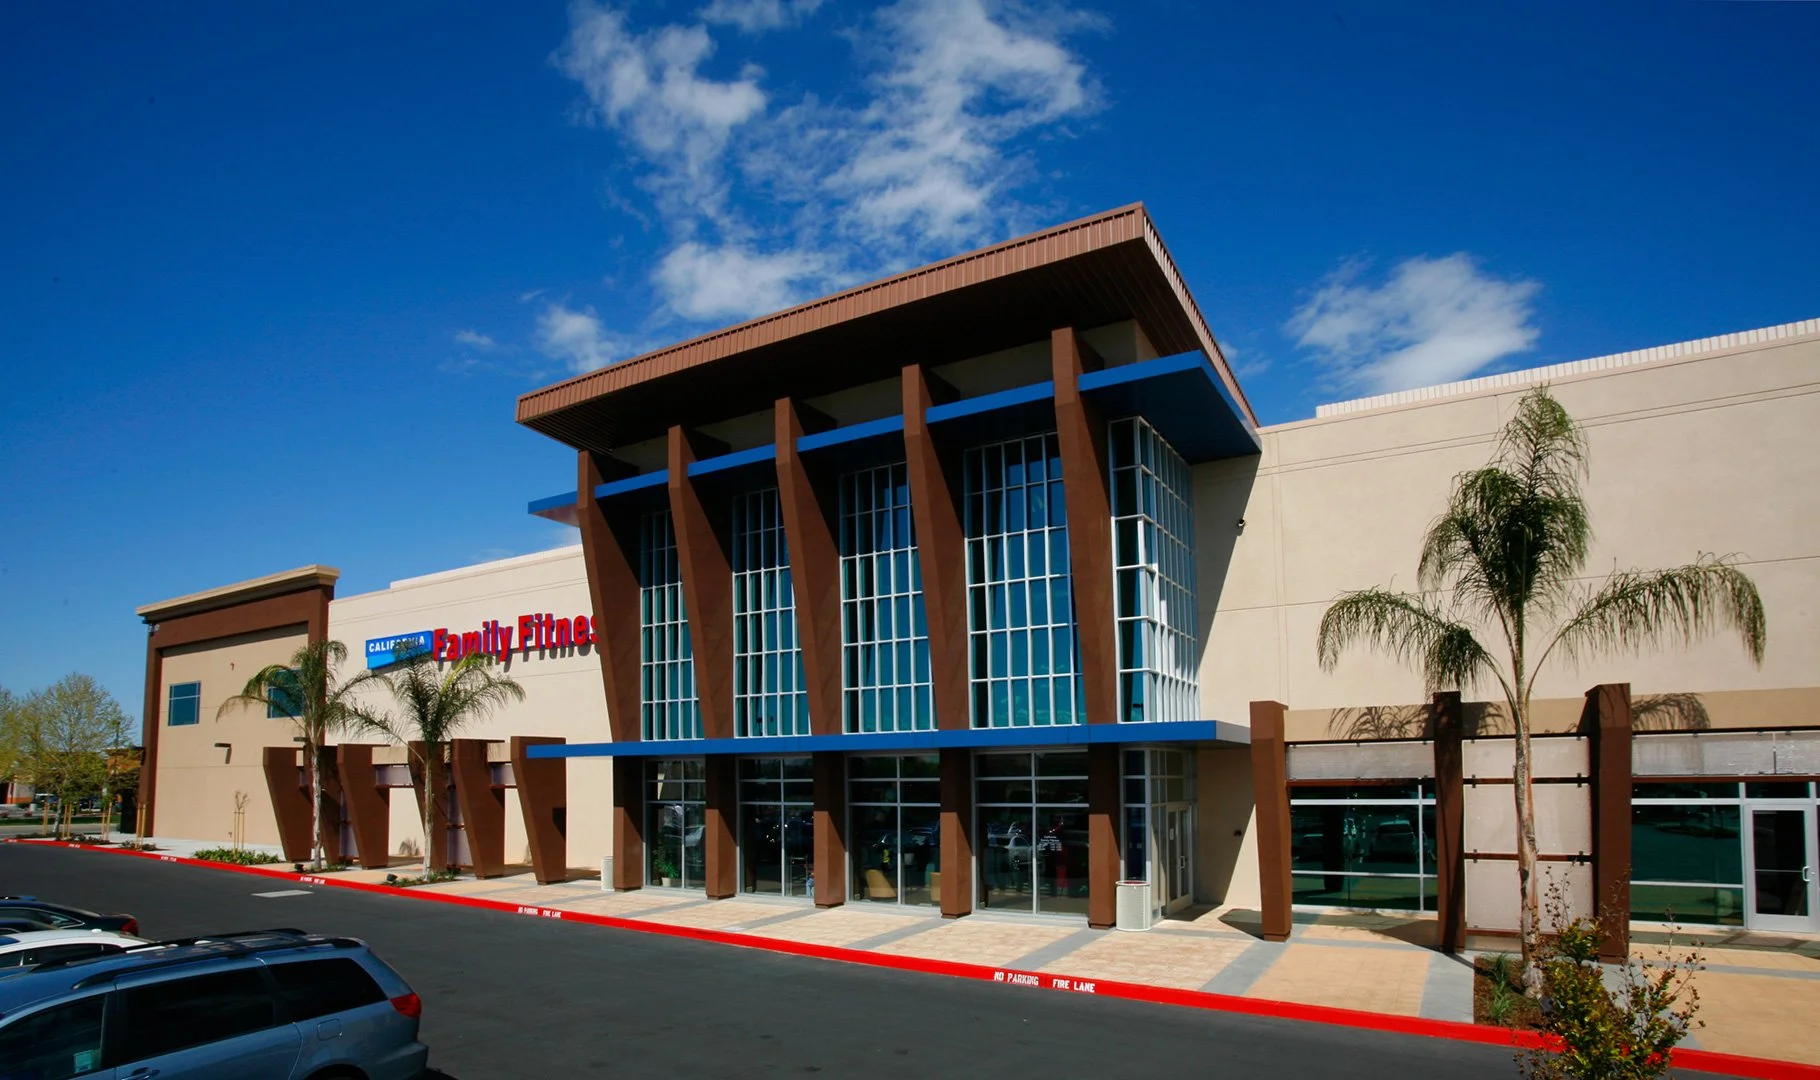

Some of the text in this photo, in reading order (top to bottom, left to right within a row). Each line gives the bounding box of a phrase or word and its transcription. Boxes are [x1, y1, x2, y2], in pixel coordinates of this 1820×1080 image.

[433, 620, 513, 662] Family
[994, 971, 1096, 993] NO PARKING FIRE LANE
